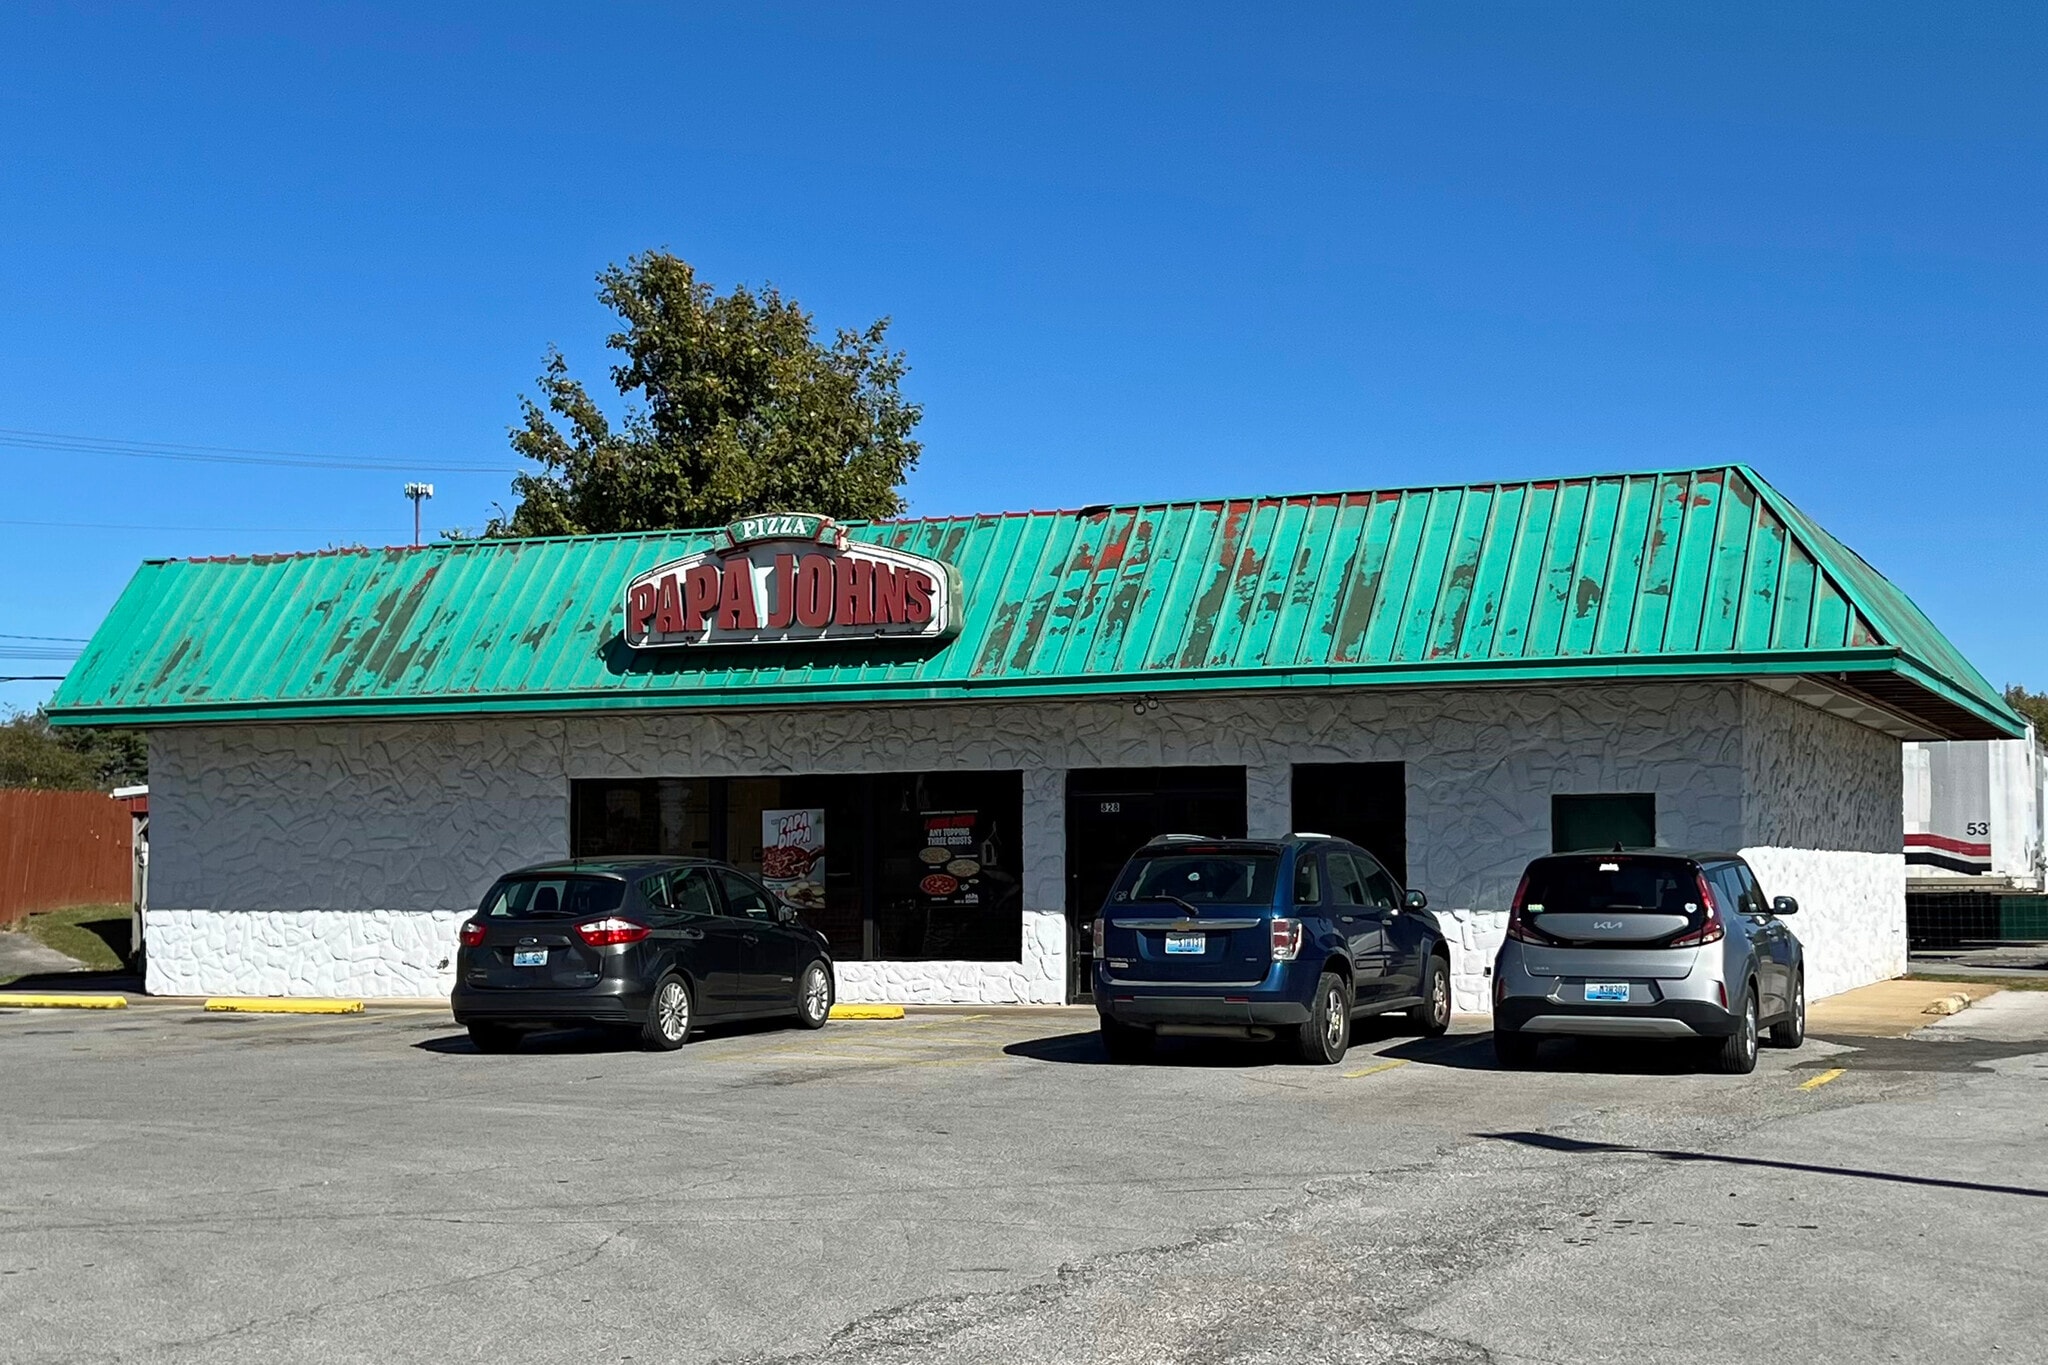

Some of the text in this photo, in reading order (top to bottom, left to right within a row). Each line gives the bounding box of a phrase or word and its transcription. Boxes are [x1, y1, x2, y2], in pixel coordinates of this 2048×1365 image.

[743, 516, 807, 538] PIZZA
[630, 554, 934, 634] PAPA JOHNS
[779, 811, 809, 834] PAPA
[929, 829, 942, 837] ANY
[777, 826, 811, 849] DIPPA
[927, 836, 973, 846] THREE CRUSTS
